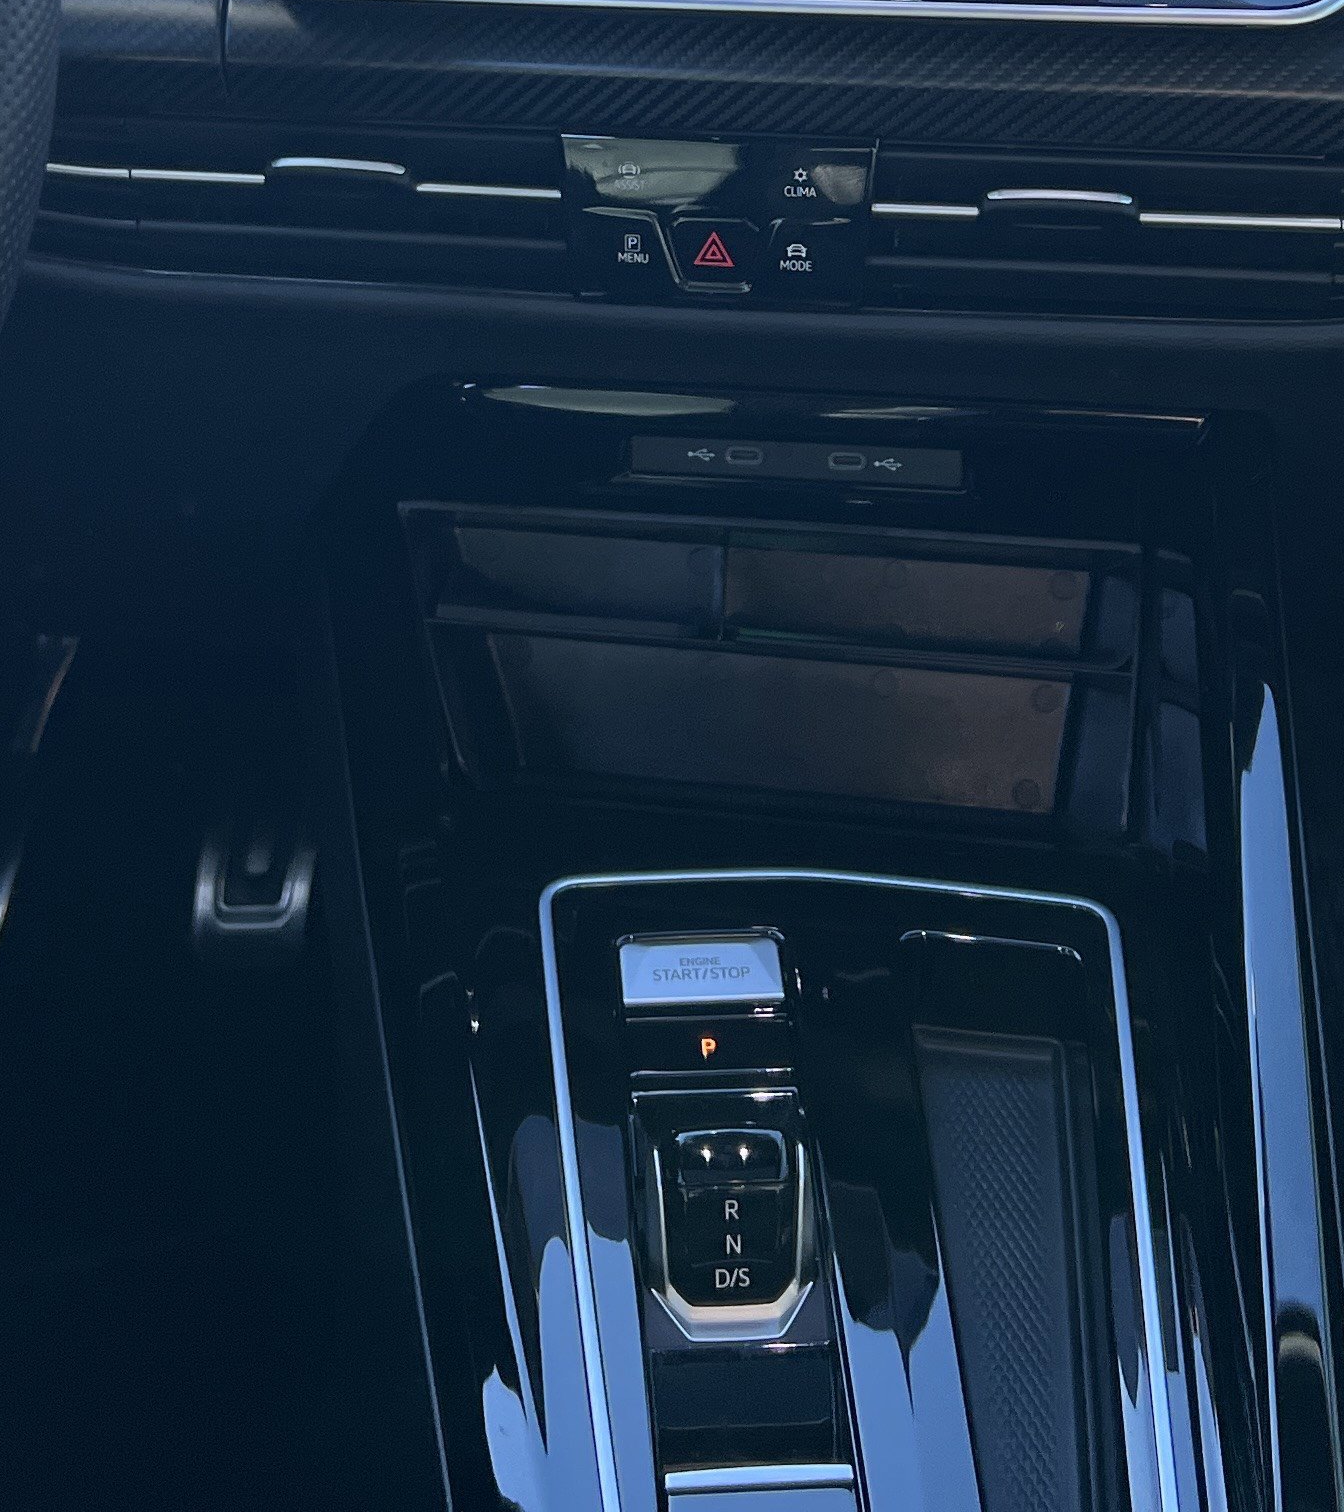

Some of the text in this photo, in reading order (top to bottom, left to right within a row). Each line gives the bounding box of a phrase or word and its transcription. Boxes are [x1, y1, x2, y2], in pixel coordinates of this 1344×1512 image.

[783, 185, 817, 199] CLIMA
[617, 251, 649, 264] MENU
[779, 259, 813, 272] MODE
[678, 956, 721, 966] ENGINE
[652, 965, 751, 982] START/STOP
[700, 1037, 717, 1058] P
[724, 1200, 739, 1221] R
[725, 1235, 742, 1254] N
[714, 1267, 751, 1288] D/S
